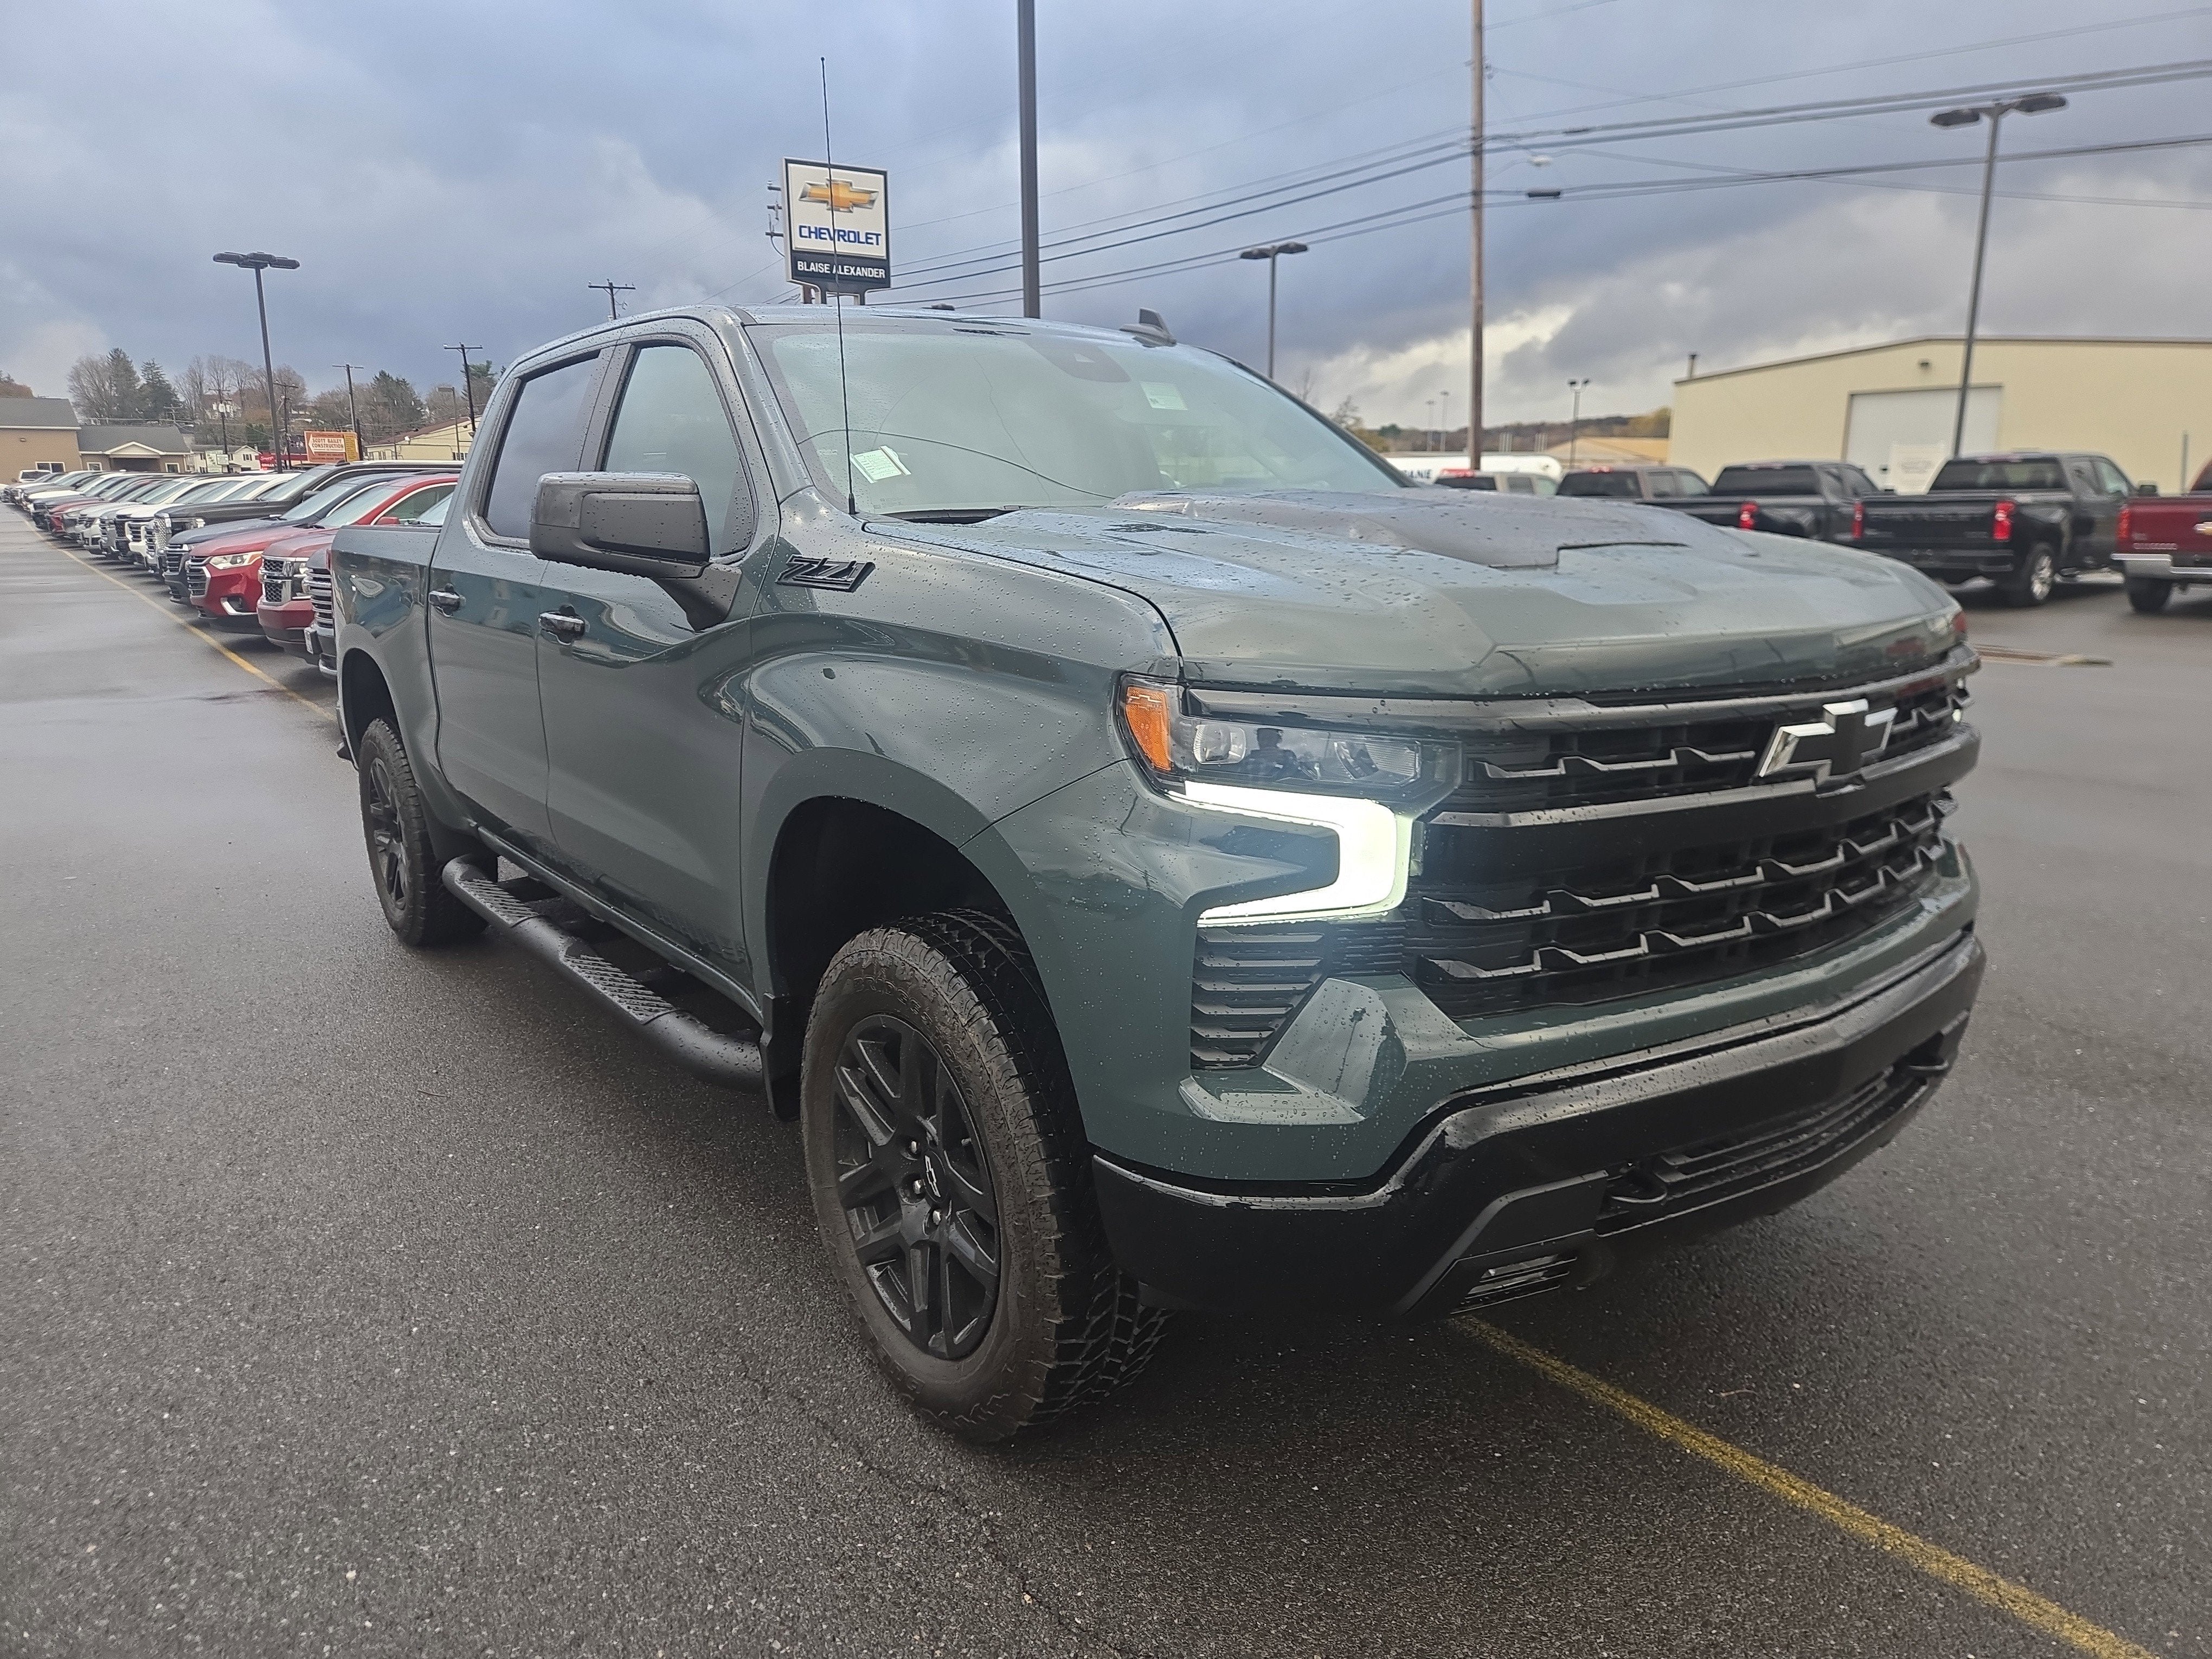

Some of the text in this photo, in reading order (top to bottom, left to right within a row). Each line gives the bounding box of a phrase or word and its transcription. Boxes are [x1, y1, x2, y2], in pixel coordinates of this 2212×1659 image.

[799, 225, 882, 246] CHEVROLET
[797, 261, 885, 279] BLAISE ALEXANDER
